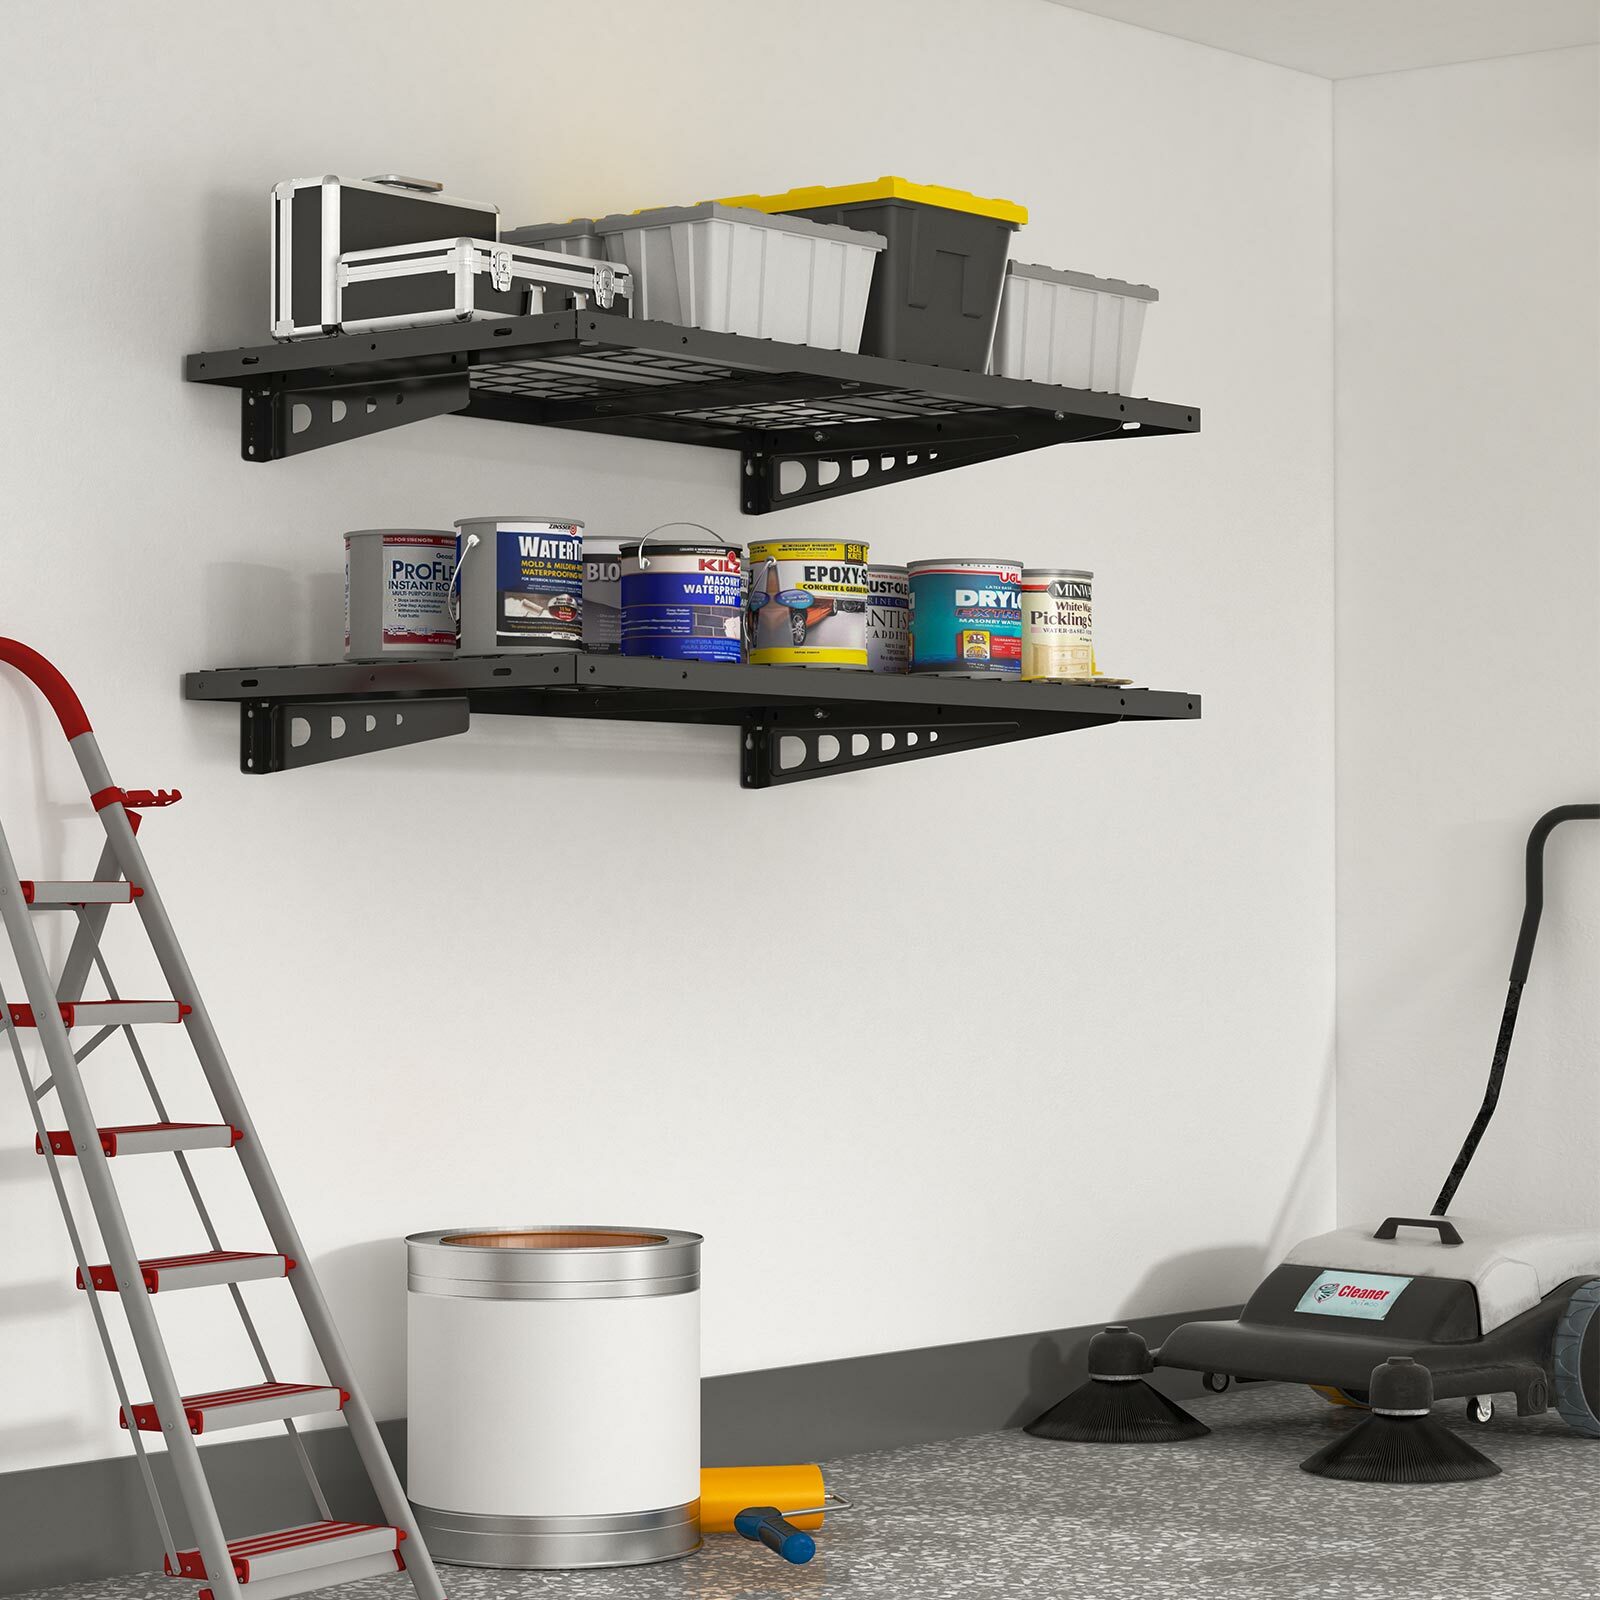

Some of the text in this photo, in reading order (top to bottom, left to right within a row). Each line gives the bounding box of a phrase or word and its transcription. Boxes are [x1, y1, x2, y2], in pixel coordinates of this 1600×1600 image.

[521, 560, 545, 568] MOLD
[586, 562, 621, 581] BLO
[1000, 571, 1021, 584] UGL
[388, 580, 433, 590] INSTANT
[704, 575, 740, 587] MASONRY
[803, 582, 838, 592] CONCRETE
[868, 580, 908, 596] UST-OLE
[714, 595, 736, 606] PAINT
[1055, 601, 1082, 612] White
[1030, 610, 1088, 629] Pickling
[1338, 1285, 1390, 1301] Cleaner
